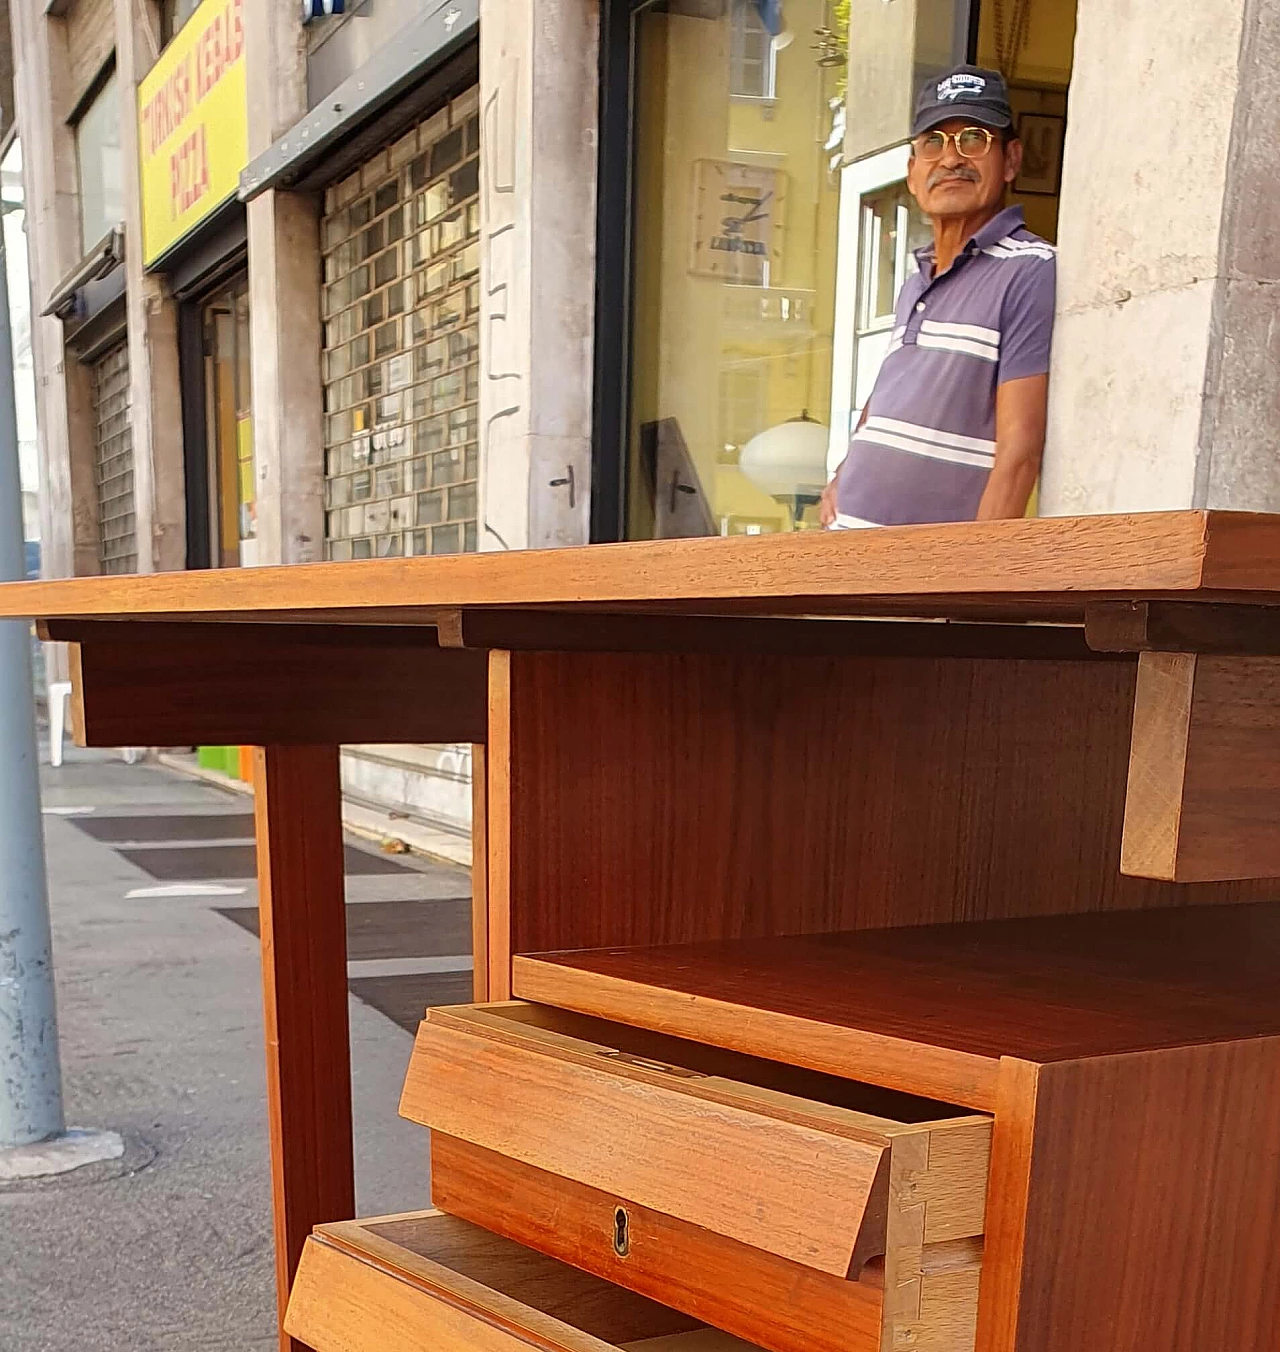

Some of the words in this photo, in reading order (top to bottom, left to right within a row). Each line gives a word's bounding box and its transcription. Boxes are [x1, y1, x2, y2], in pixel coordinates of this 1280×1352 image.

[141, 51, 193, 162] TURKISH
[196, 0, 244, 104] KEBAB
[171, 123, 210, 221] PIZZA
